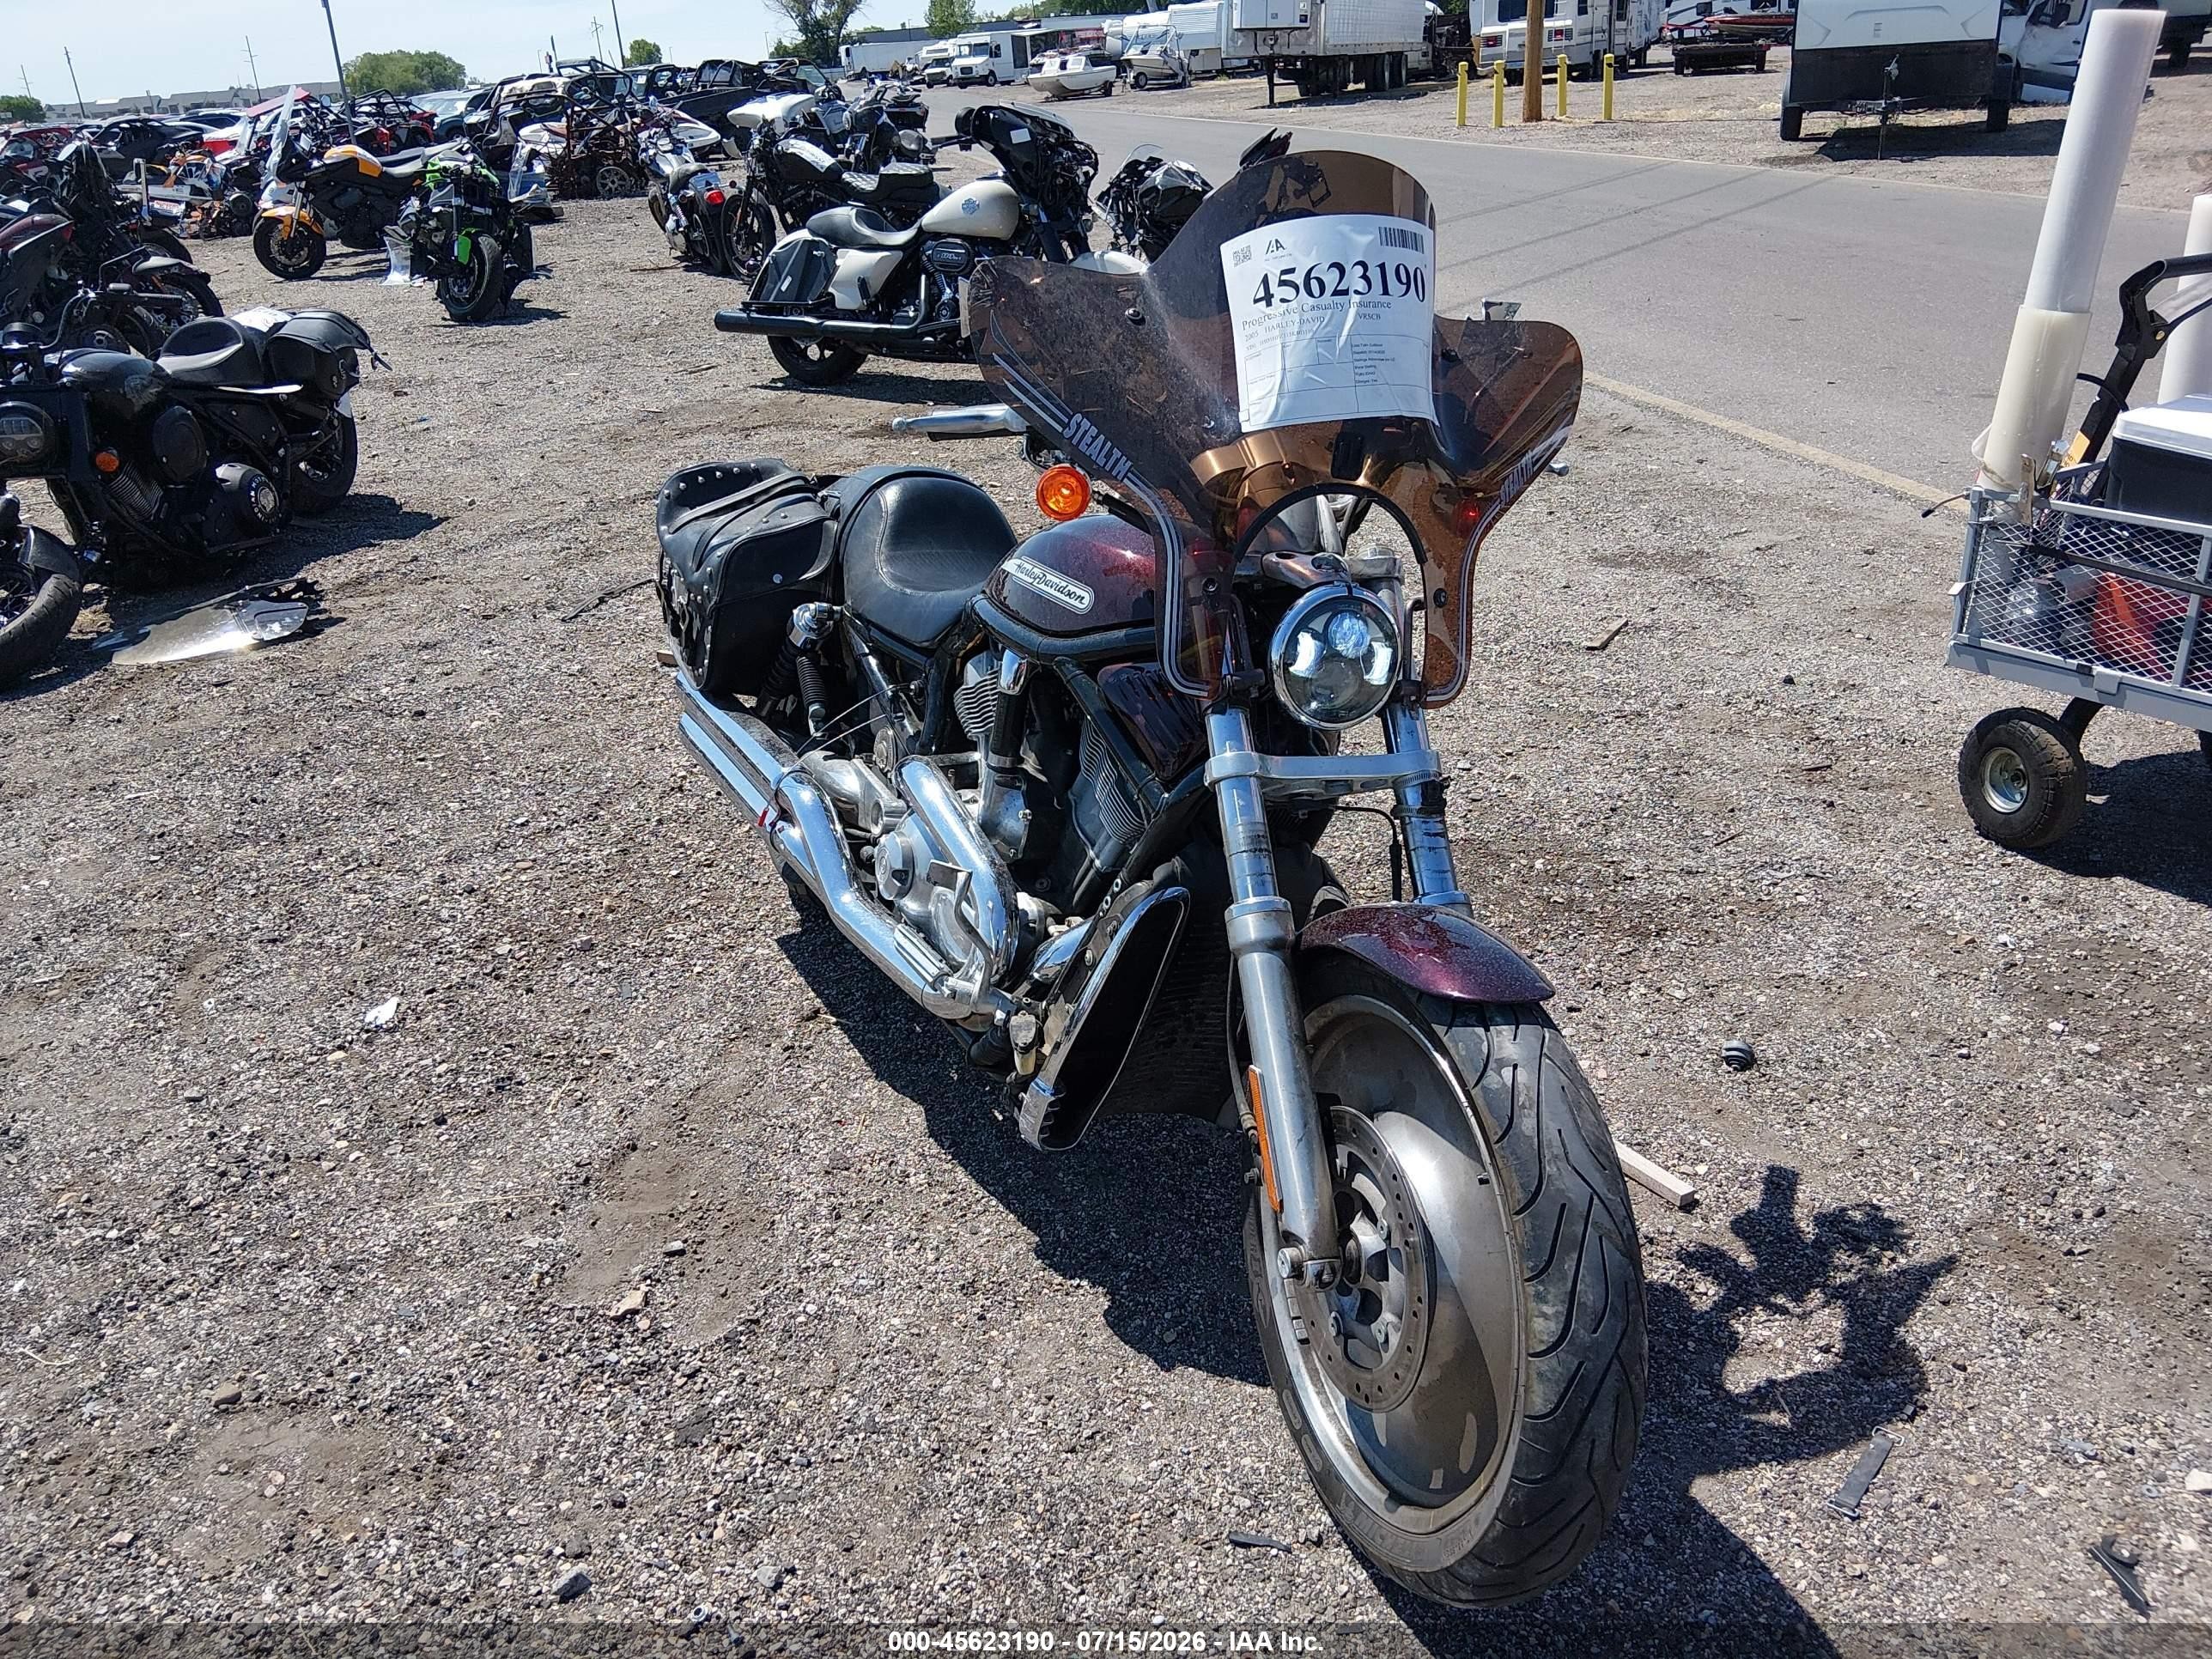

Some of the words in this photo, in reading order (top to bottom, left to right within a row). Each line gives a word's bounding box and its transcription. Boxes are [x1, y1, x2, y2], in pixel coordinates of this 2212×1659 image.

[1253, 260, 1425, 308] 45623190
[1242, 307, 1298, 331] Progressive
[1301, 300, 1345, 312] Casualty
[1348, 300, 1392, 309] Insurance
[1244, 331, 1259, 342] 2005
[1063, 413, 1132, 481] STEALTH
